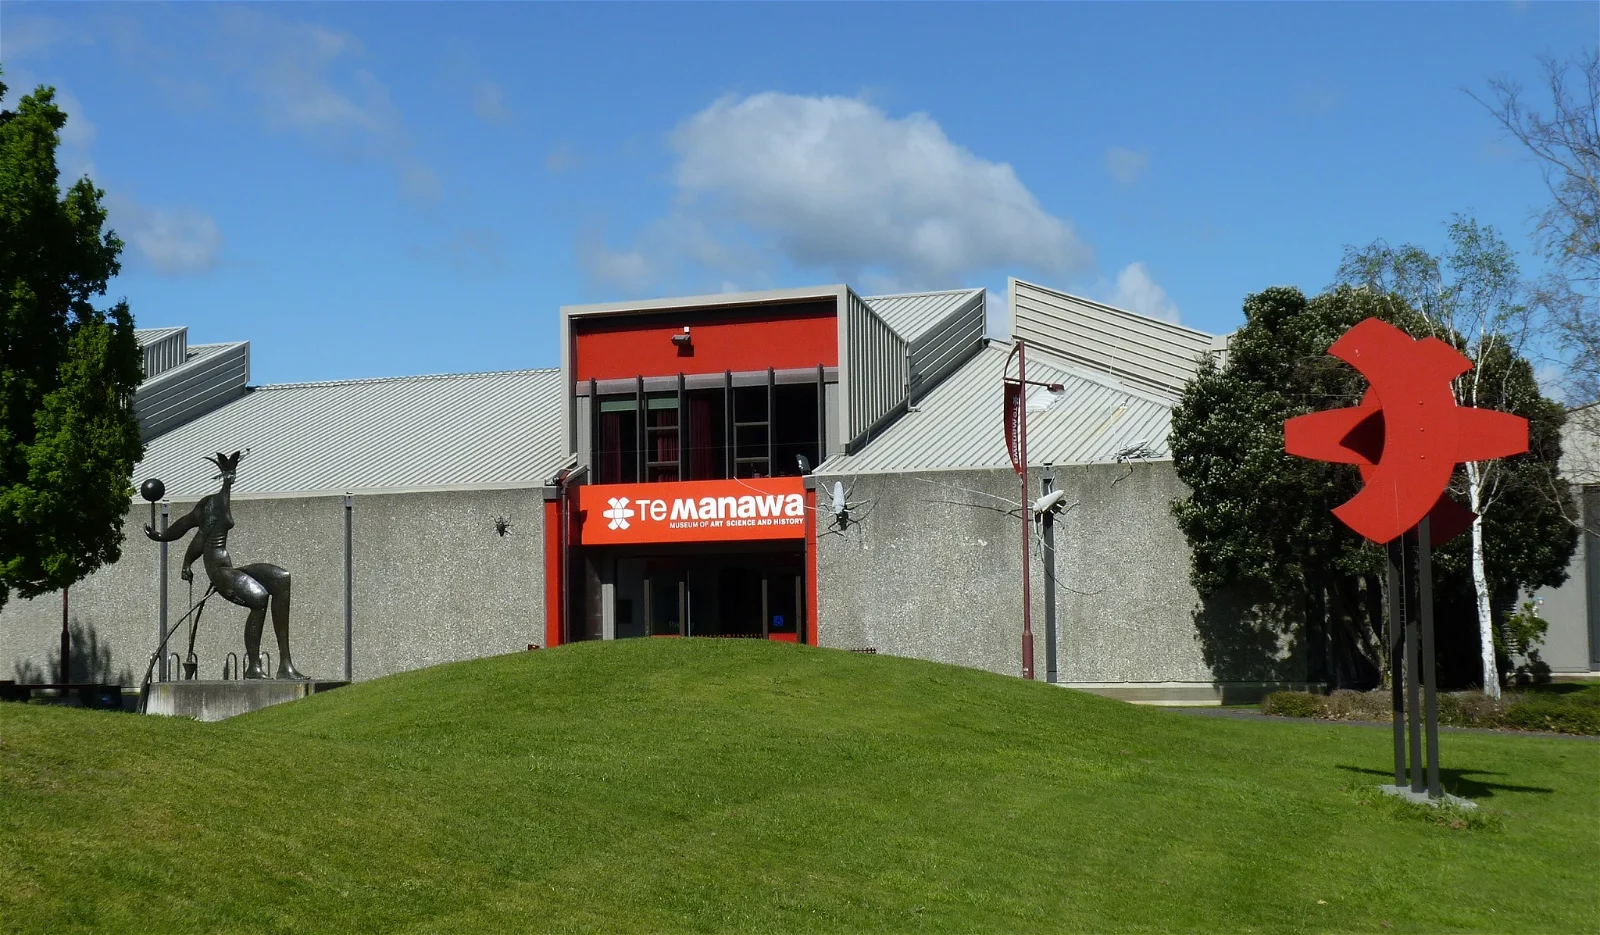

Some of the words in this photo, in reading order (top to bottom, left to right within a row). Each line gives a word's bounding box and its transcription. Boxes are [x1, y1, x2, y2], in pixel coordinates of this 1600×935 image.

[635, 499, 667, 521] Te
[669, 521, 698, 529] MUSEUM
[726, 519, 756, 527] SCIENCE
[757, 518, 772, 526] AND
[773, 517, 804, 525] HISTORY
